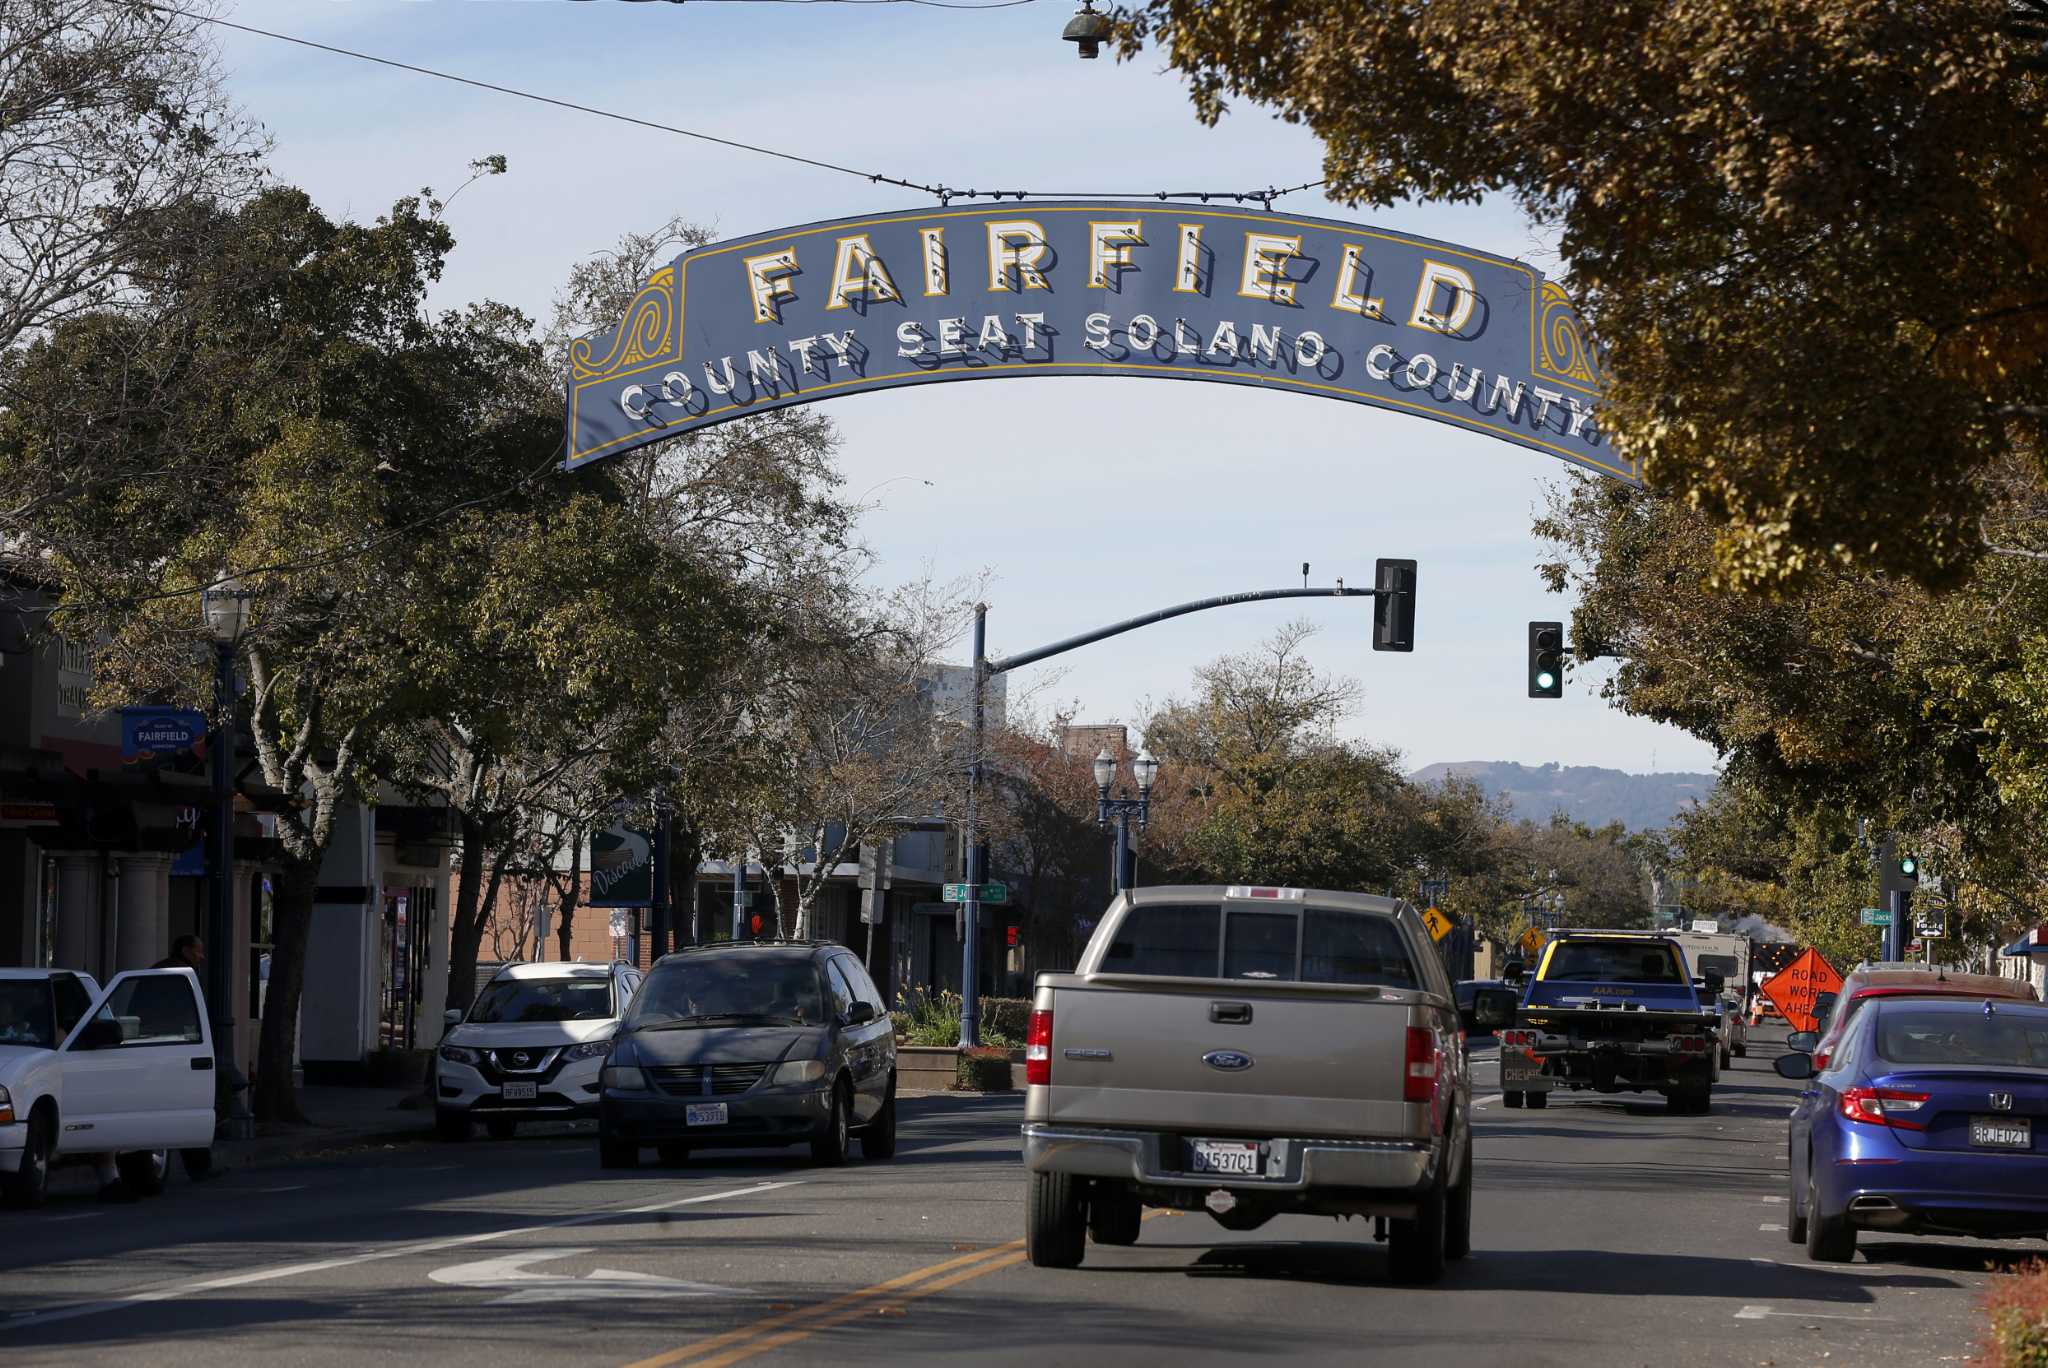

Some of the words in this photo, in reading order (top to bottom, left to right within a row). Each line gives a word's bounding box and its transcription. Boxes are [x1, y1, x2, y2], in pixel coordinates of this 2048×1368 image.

[743, 219, 1476, 334] FAIRFIELD
[620, 329, 855, 421] COUNTY
[898, 312, 1043, 358] SEAT
[1083, 312, 1325, 368] SOLANO
[1366, 344, 1595, 438] COUNTY
[138, 731, 189, 742] FAIRFIELD
[592, 854, 650, 896] Discover
[1791, 968, 1827, 983] ROAD
[1784, 1002, 1811, 1017] AHE
[1213, 1054, 1241, 1067] Ford
